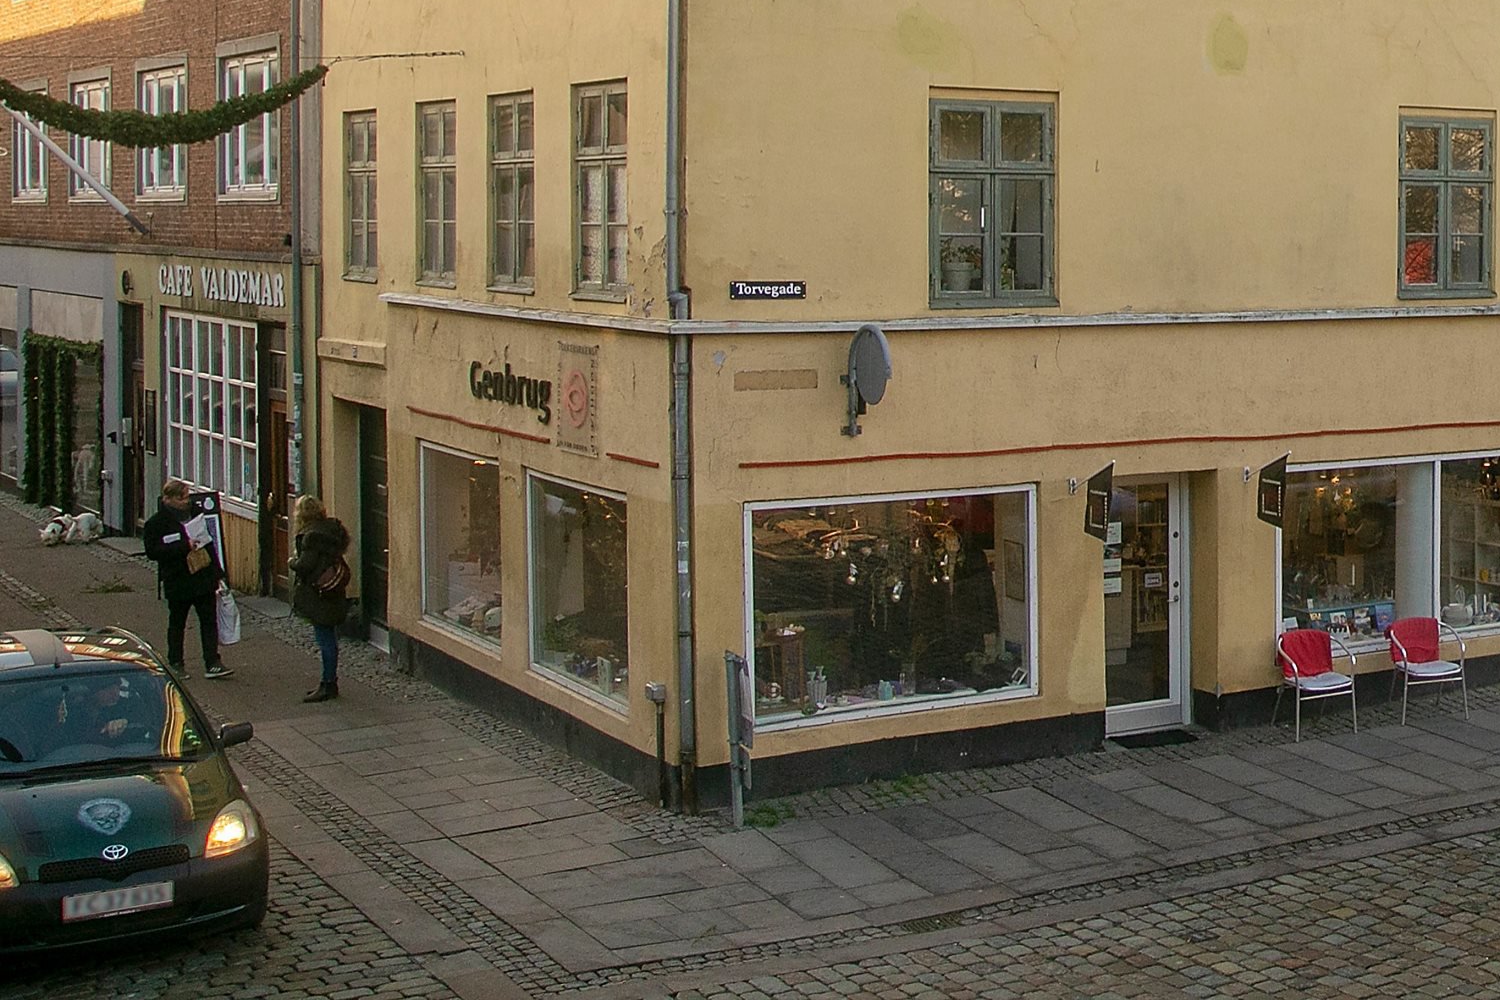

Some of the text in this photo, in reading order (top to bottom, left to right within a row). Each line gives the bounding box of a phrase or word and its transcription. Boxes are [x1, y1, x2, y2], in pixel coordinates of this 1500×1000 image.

[159, 264, 285, 308] CAFE VALDEMAR
[735, 282, 802, 298] Torvegade
[469, 360, 552, 426] Genbrug
